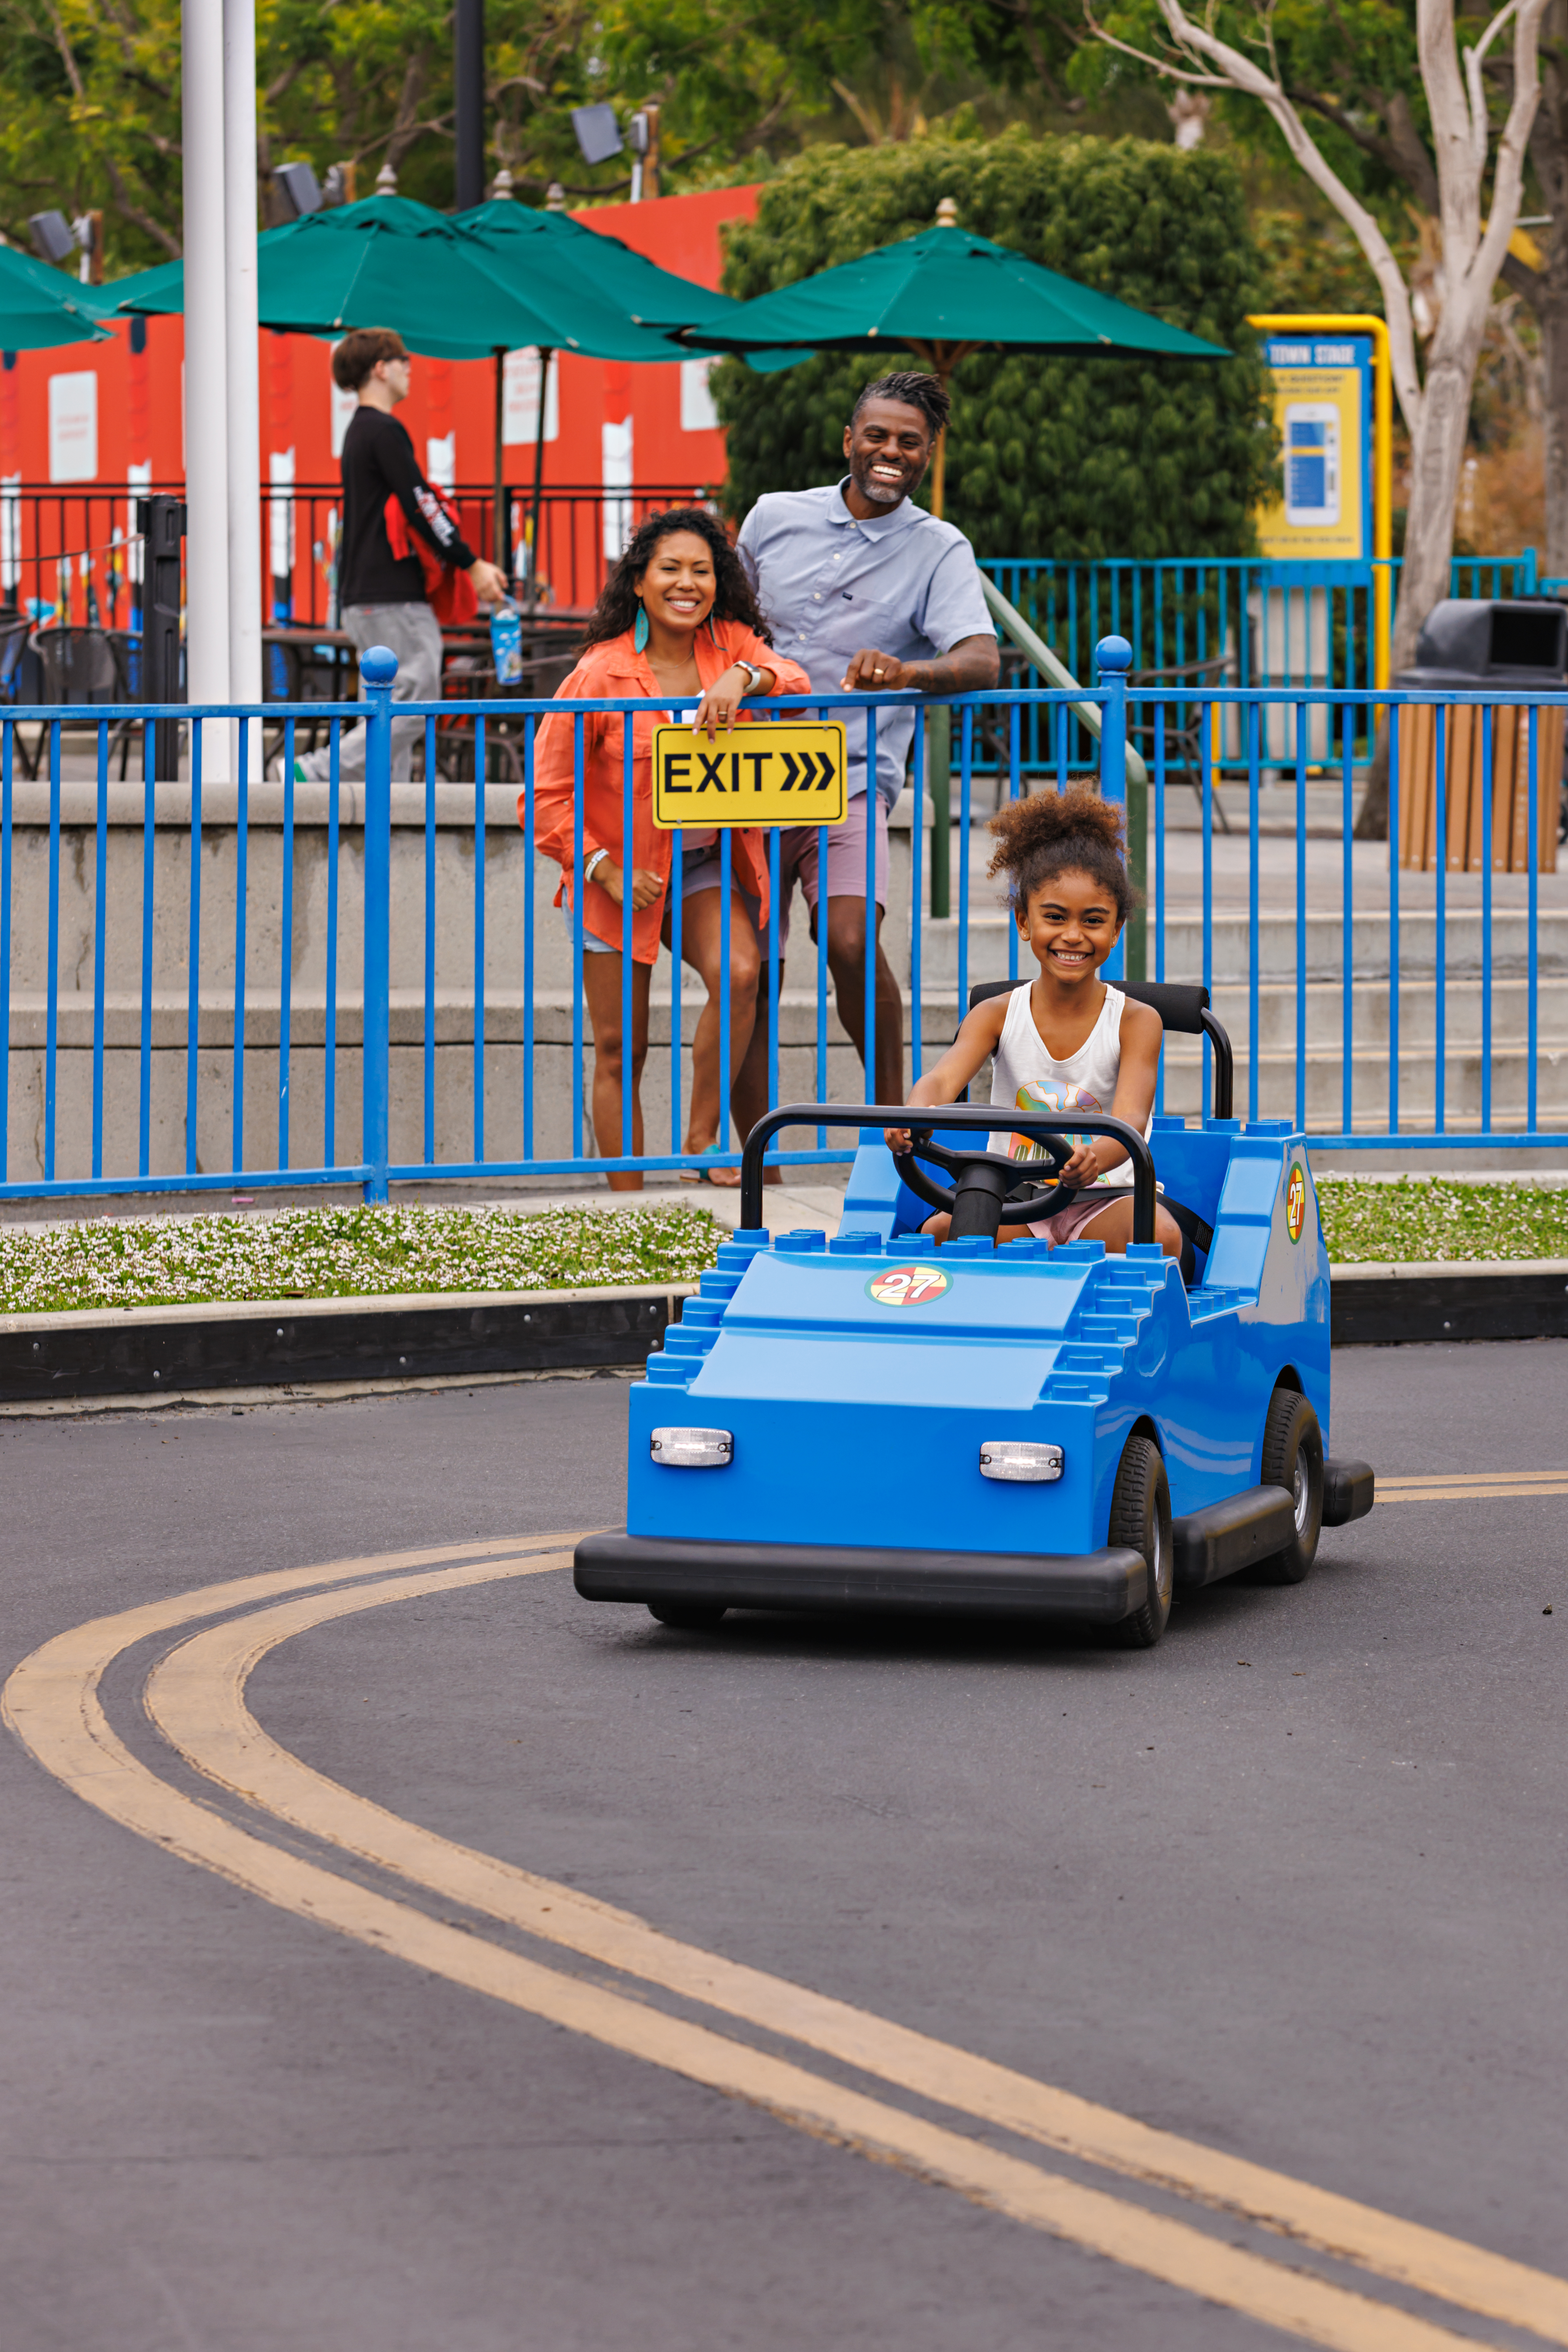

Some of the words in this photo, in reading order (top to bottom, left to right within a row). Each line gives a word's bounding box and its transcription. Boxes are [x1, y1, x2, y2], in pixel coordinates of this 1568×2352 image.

[1269, 344, 1311, 364] TOWN
[1314, 344, 1356, 365] STAGE
[664, 752, 773, 793] EXIT
[1289, 1181, 1303, 1228] 27
[876, 1273, 942, 1299] 27
